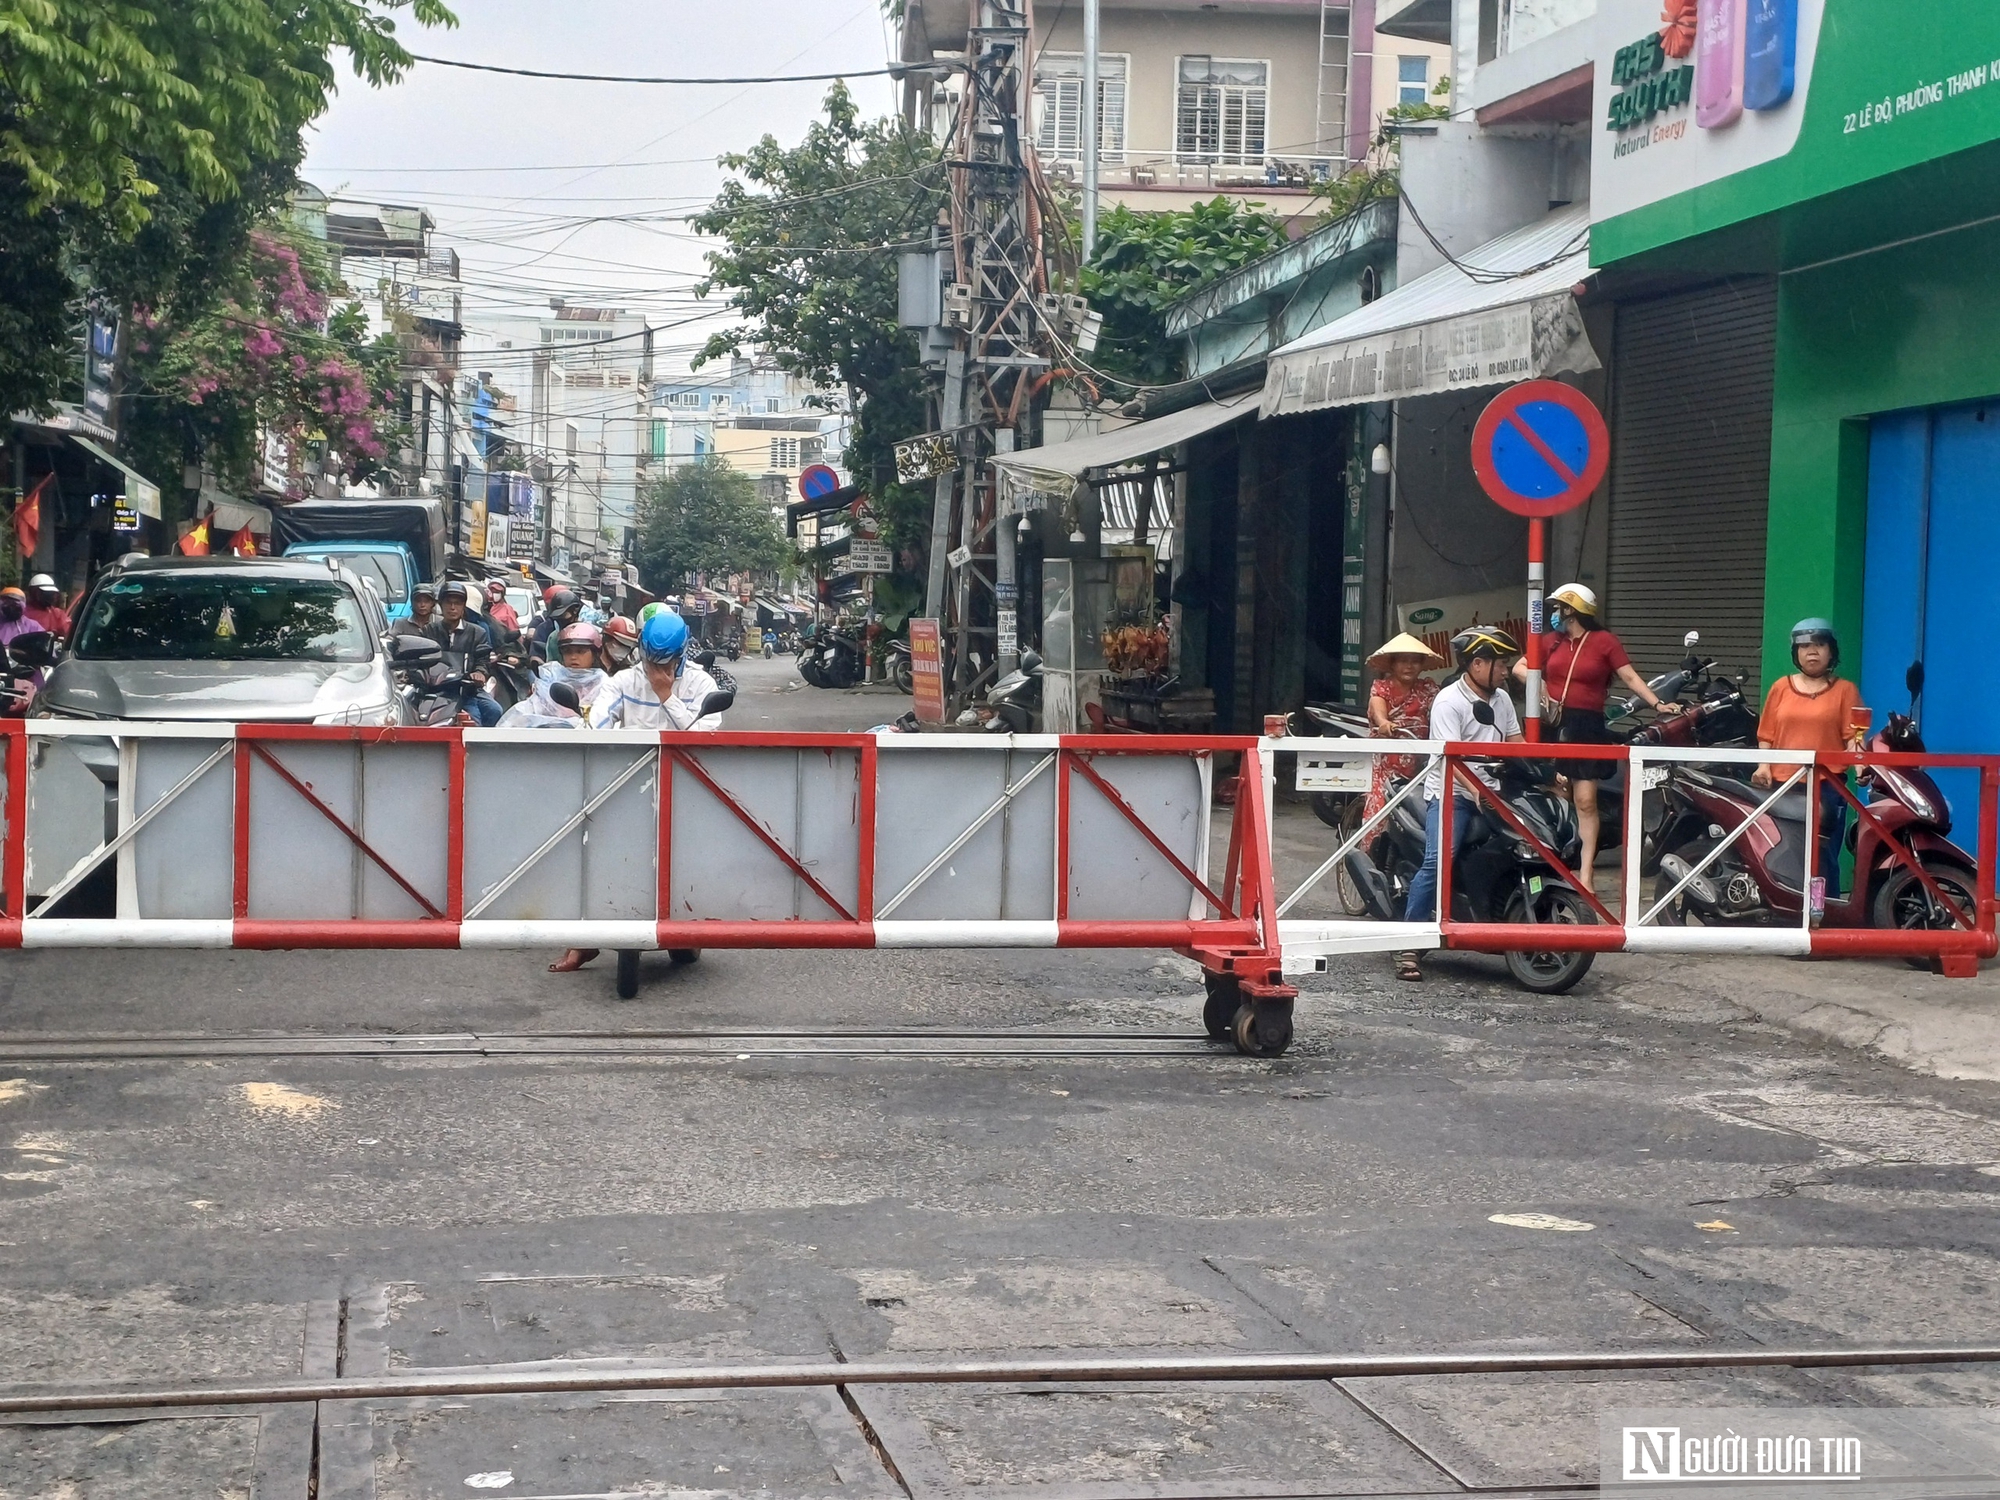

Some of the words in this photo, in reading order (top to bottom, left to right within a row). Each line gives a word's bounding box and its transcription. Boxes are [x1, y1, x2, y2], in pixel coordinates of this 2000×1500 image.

[1611, 31, 1664, 86] GAS
[1606, 64, 1694, 132] SOUTH
[1843, 112, 1856, 134] 22
[1859, 101, 1872, 128] LÊ
[1896, 79, 1944, 116] PHƯỜNG
[1946, 64, 1987, 97] THANH
[1614, 128, 1650, 160] Natural
[1653, 118, 1687, 144] Energy
[511, 530, 535, 542] QUANG
